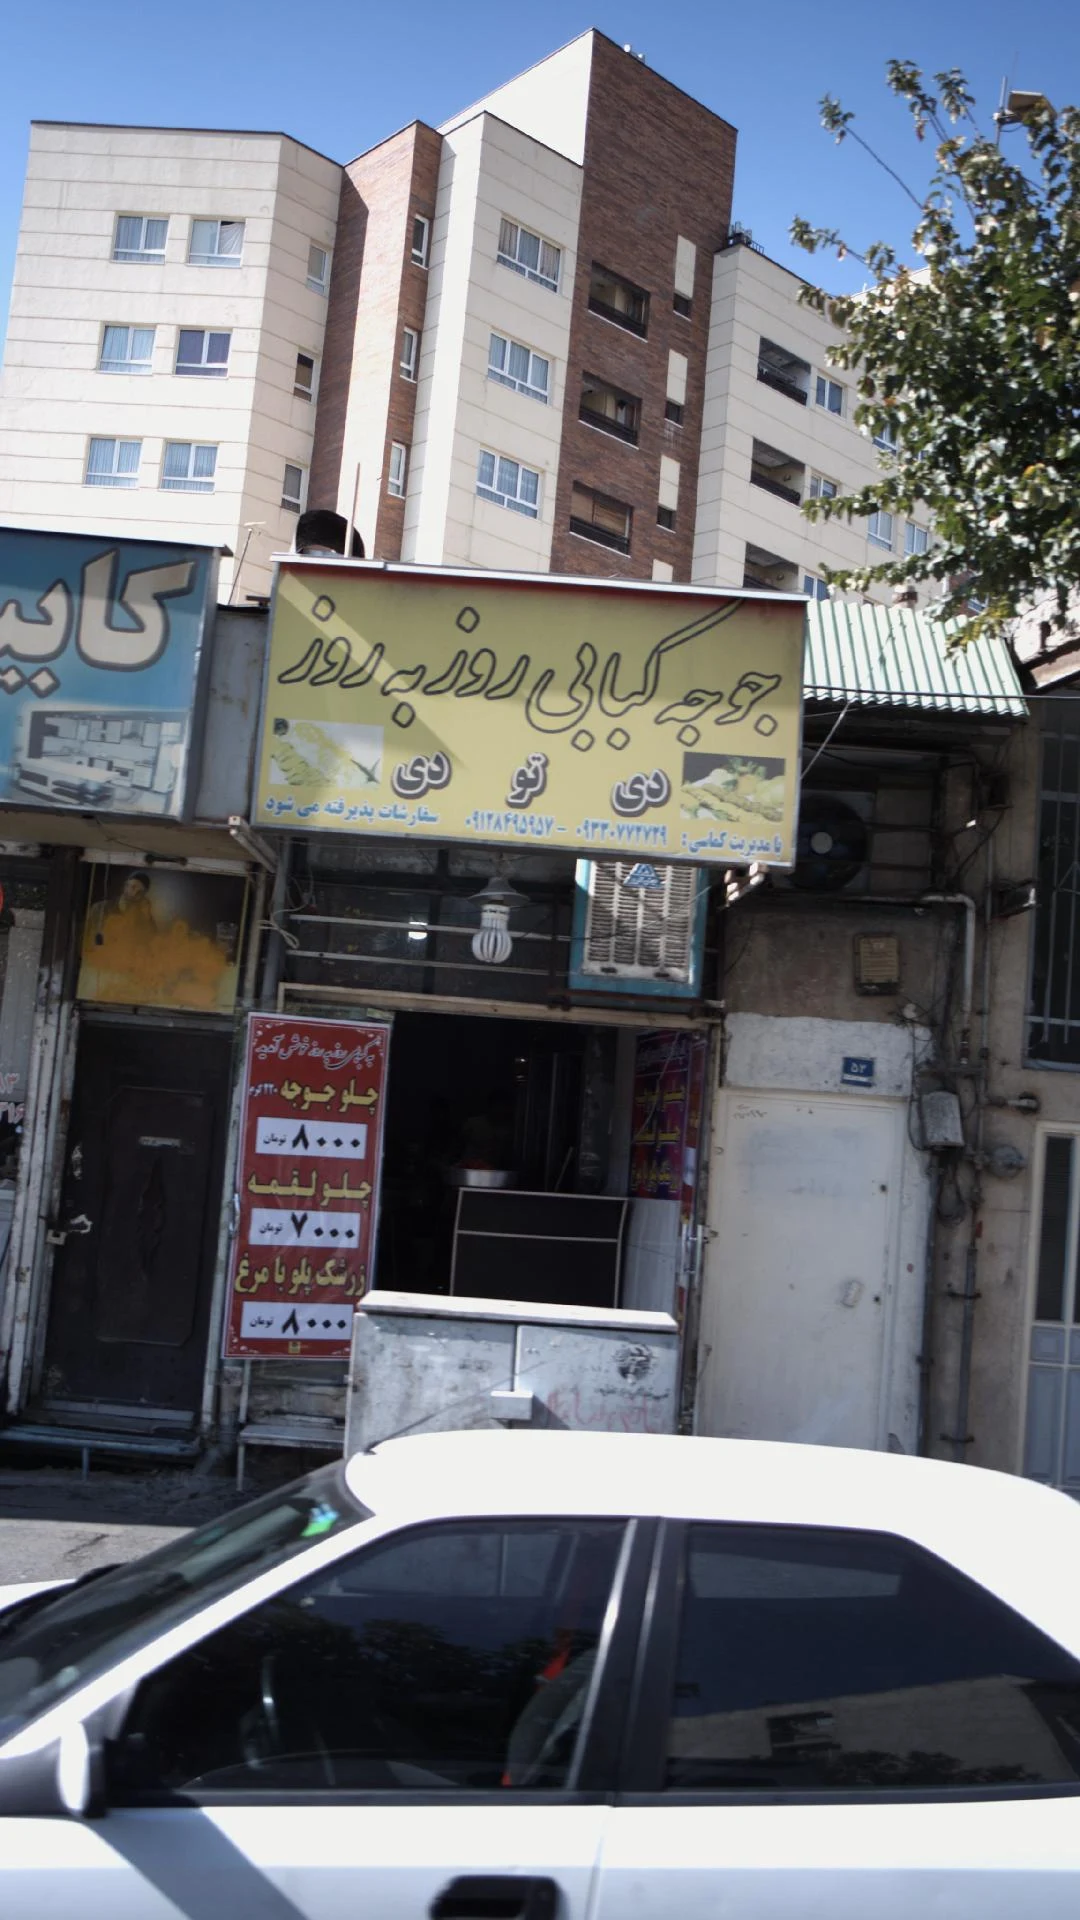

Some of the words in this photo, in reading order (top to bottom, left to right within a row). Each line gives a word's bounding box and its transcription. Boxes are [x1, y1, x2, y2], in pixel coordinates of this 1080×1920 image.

[278, 594, 385, 689] روز
[423, 606, 530, 700] روز
[525, 597, 746, 751] کبابی
[382, 663, 427, 728] به
[655, 670, 782, 747] جوجه
[391, 750, 453, 799] دی
[505, 751, 550, 809] تو
[611, 767, 669, 818] دی
[264, 795, 294, 816] شود
[296, 801, 320, 818] می
[324, 799, 375, 823] پذیرفته
[378, 803, 439, 827] سفارشات
[729, 835, 771, 857] مدیریت
[280, 1079, 336, 1111] جوجه
[339, 1077, 380, 1115] چلو
[263, 1133, 287, 1146] تومان
[292, 1124, 361, 1151] ۸۰۰۰
[247, 1169, 318, 1197] لقمه
[320, 1171, 372, 1208] چلو
[259, 1222, 283, 1235] تومان
[290, 1212, 356, 1239] ۷۰۰۰
[234, 1252, 270, 1294] مرغ
[274, 1256, 286, 1292] با
[288, 1257, 312, 1295] پلو
[316, 1257, 366, 1297] زرشک
[250, 1315, 274, 1329] تومان
[281, 1308, 347, 1336] ۸۰۰۰
